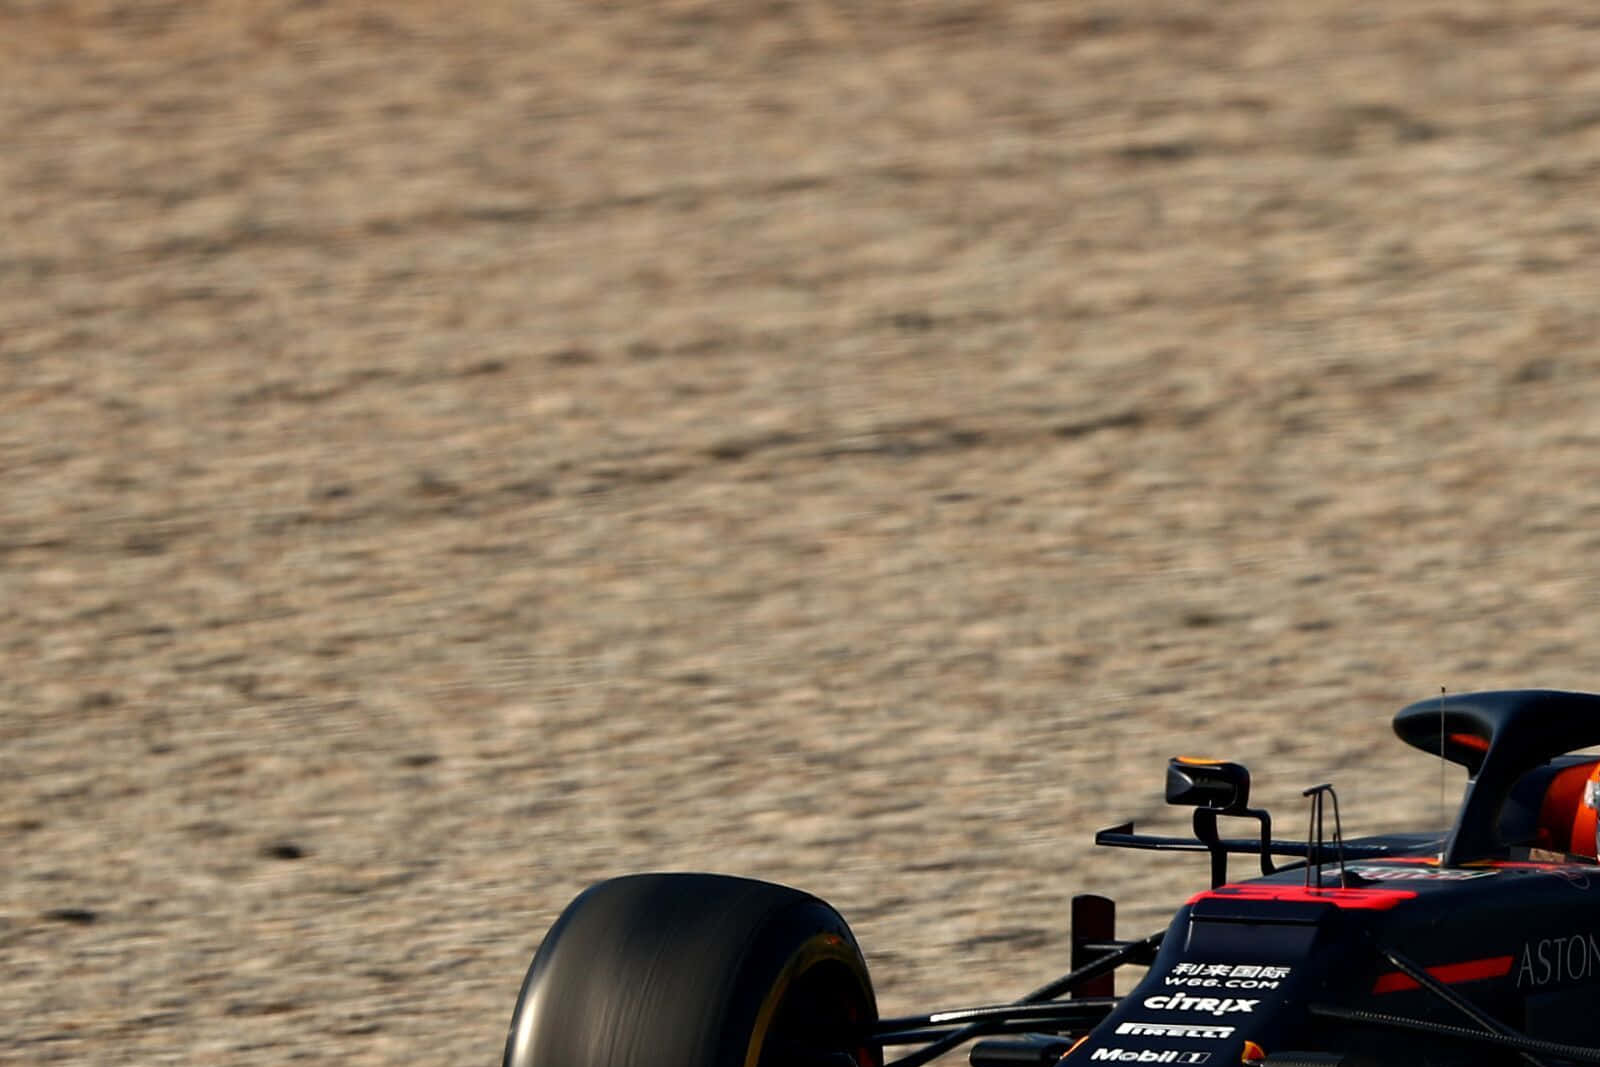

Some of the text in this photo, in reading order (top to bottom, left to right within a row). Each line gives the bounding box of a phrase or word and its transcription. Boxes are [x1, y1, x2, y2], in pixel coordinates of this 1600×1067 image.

[1172, 963, 1291, 978] 利来国际
[1115, 1023, 1235, 1038] PIRELLI
[1091, 1048, 1178, 1063] Mobil
